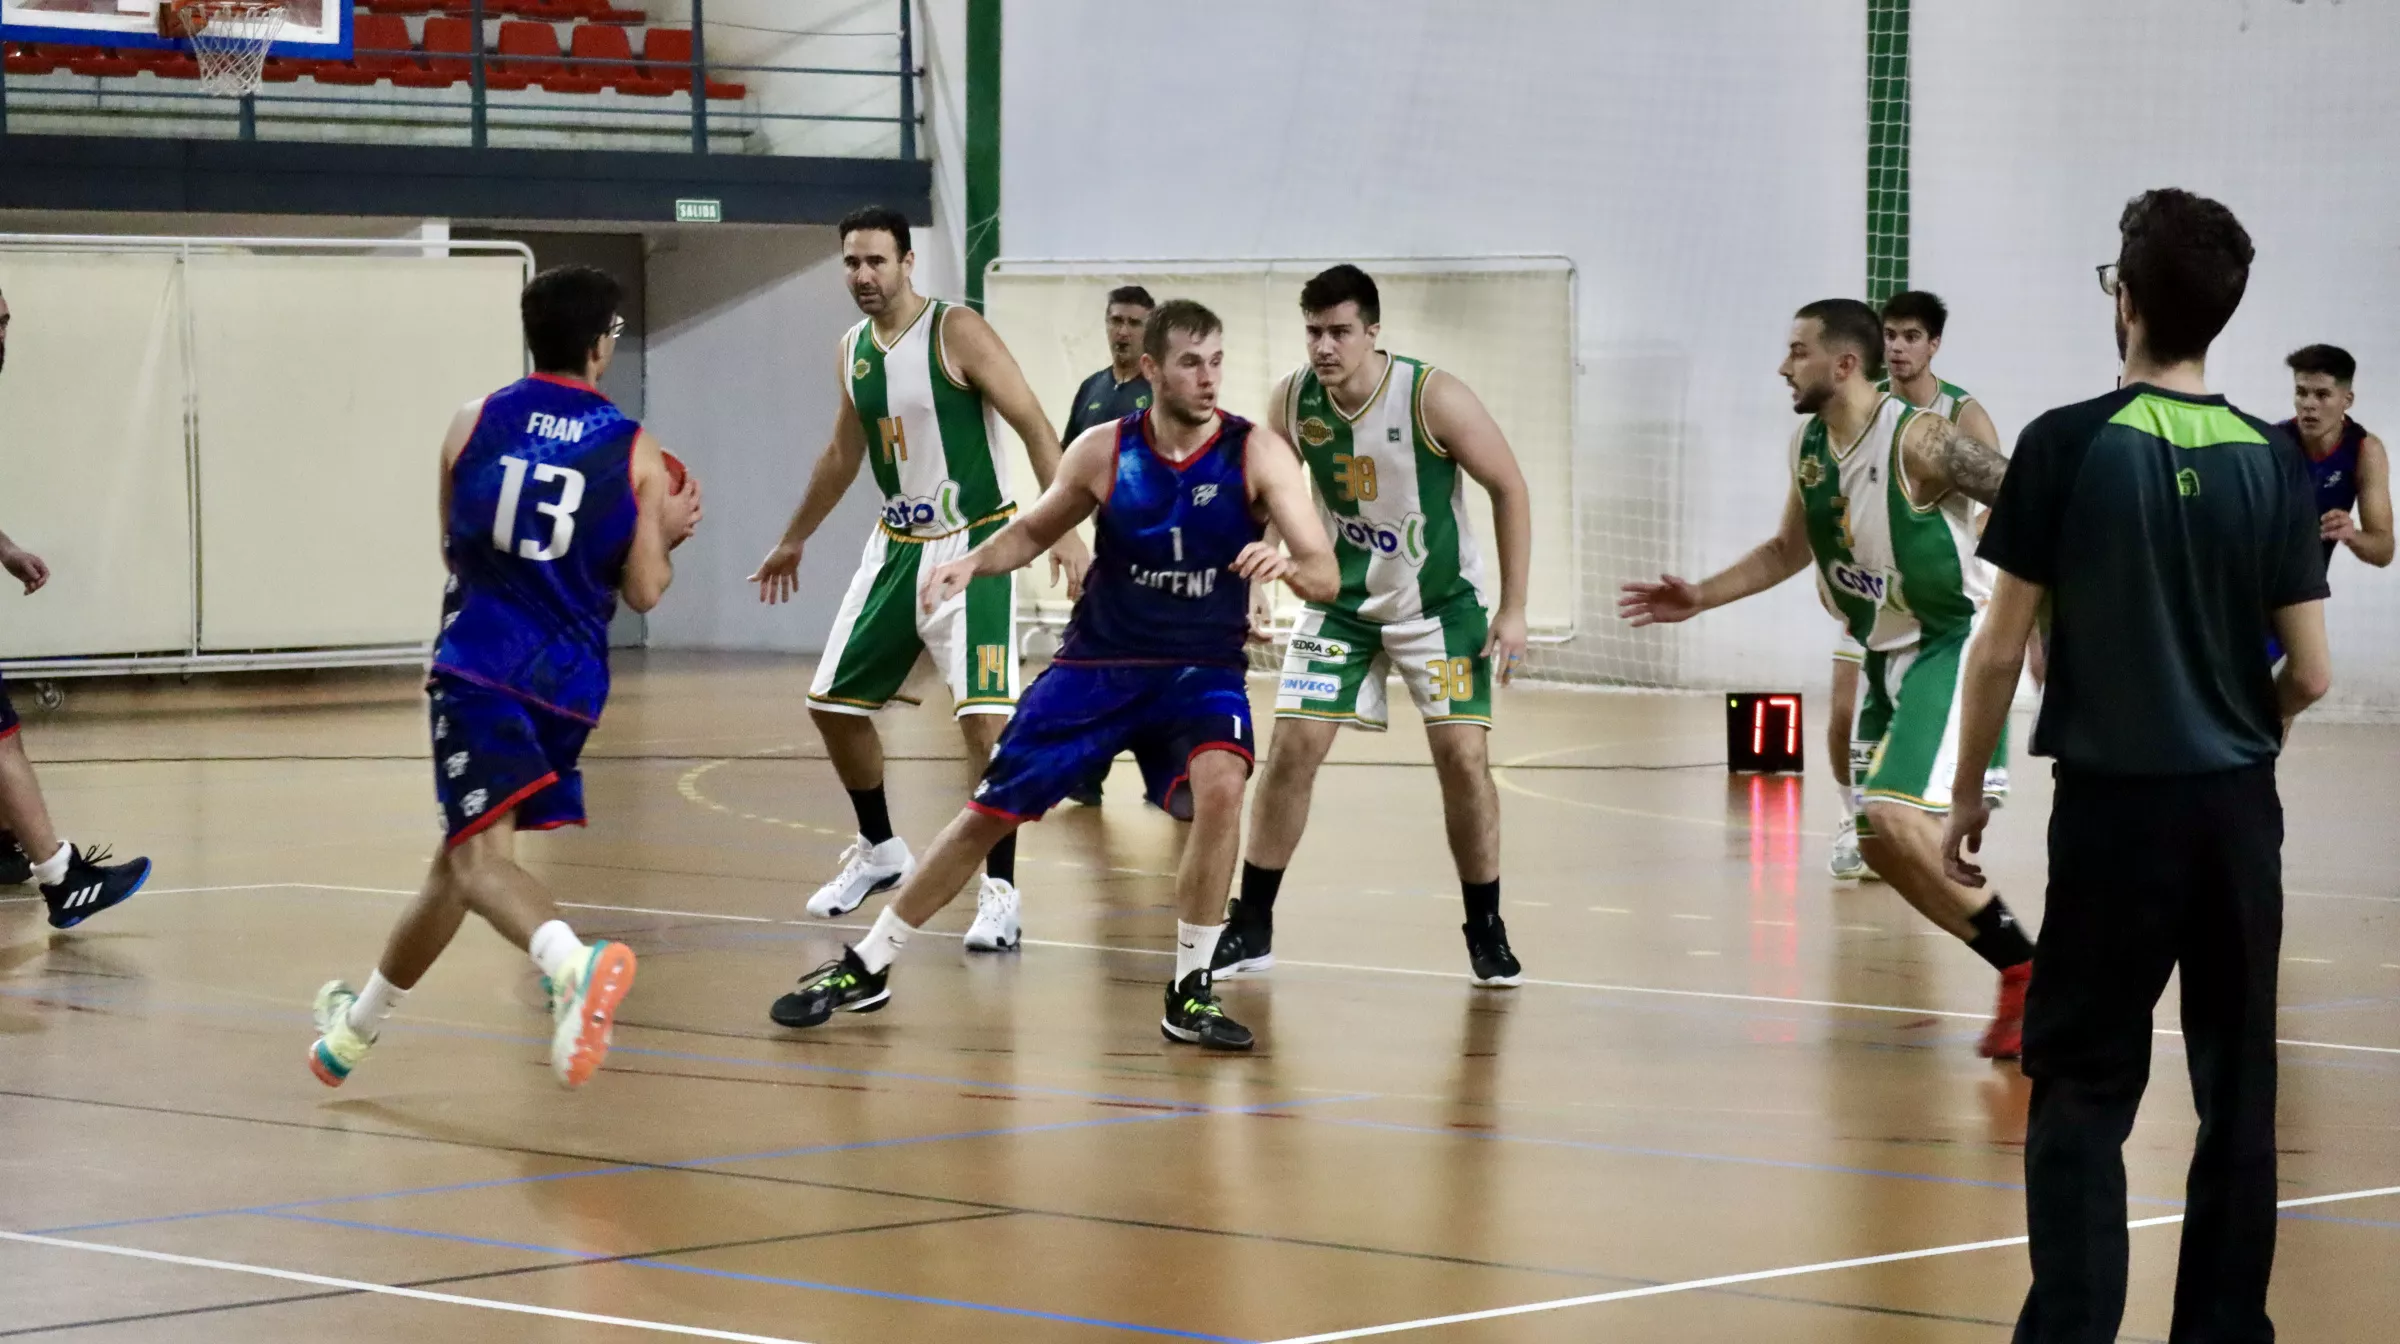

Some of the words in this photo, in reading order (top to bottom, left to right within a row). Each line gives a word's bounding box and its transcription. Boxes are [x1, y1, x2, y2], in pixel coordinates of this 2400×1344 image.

[680, 204, 716, 218] SALIDA
[526, 412, 585, 444] FRAN
[878, 416, 907, 464] 14
[1333, 454, 1378, 502] 38
[493, 455, 586, 562] 13
[1170, 526, 1184, 562] 1
[977, 645, 1005, 690] 14
[1426, 657, 1473, 701] 38
[1232, 715, 1241, 739] 1
[1754, 697, 1796, 754] 17
